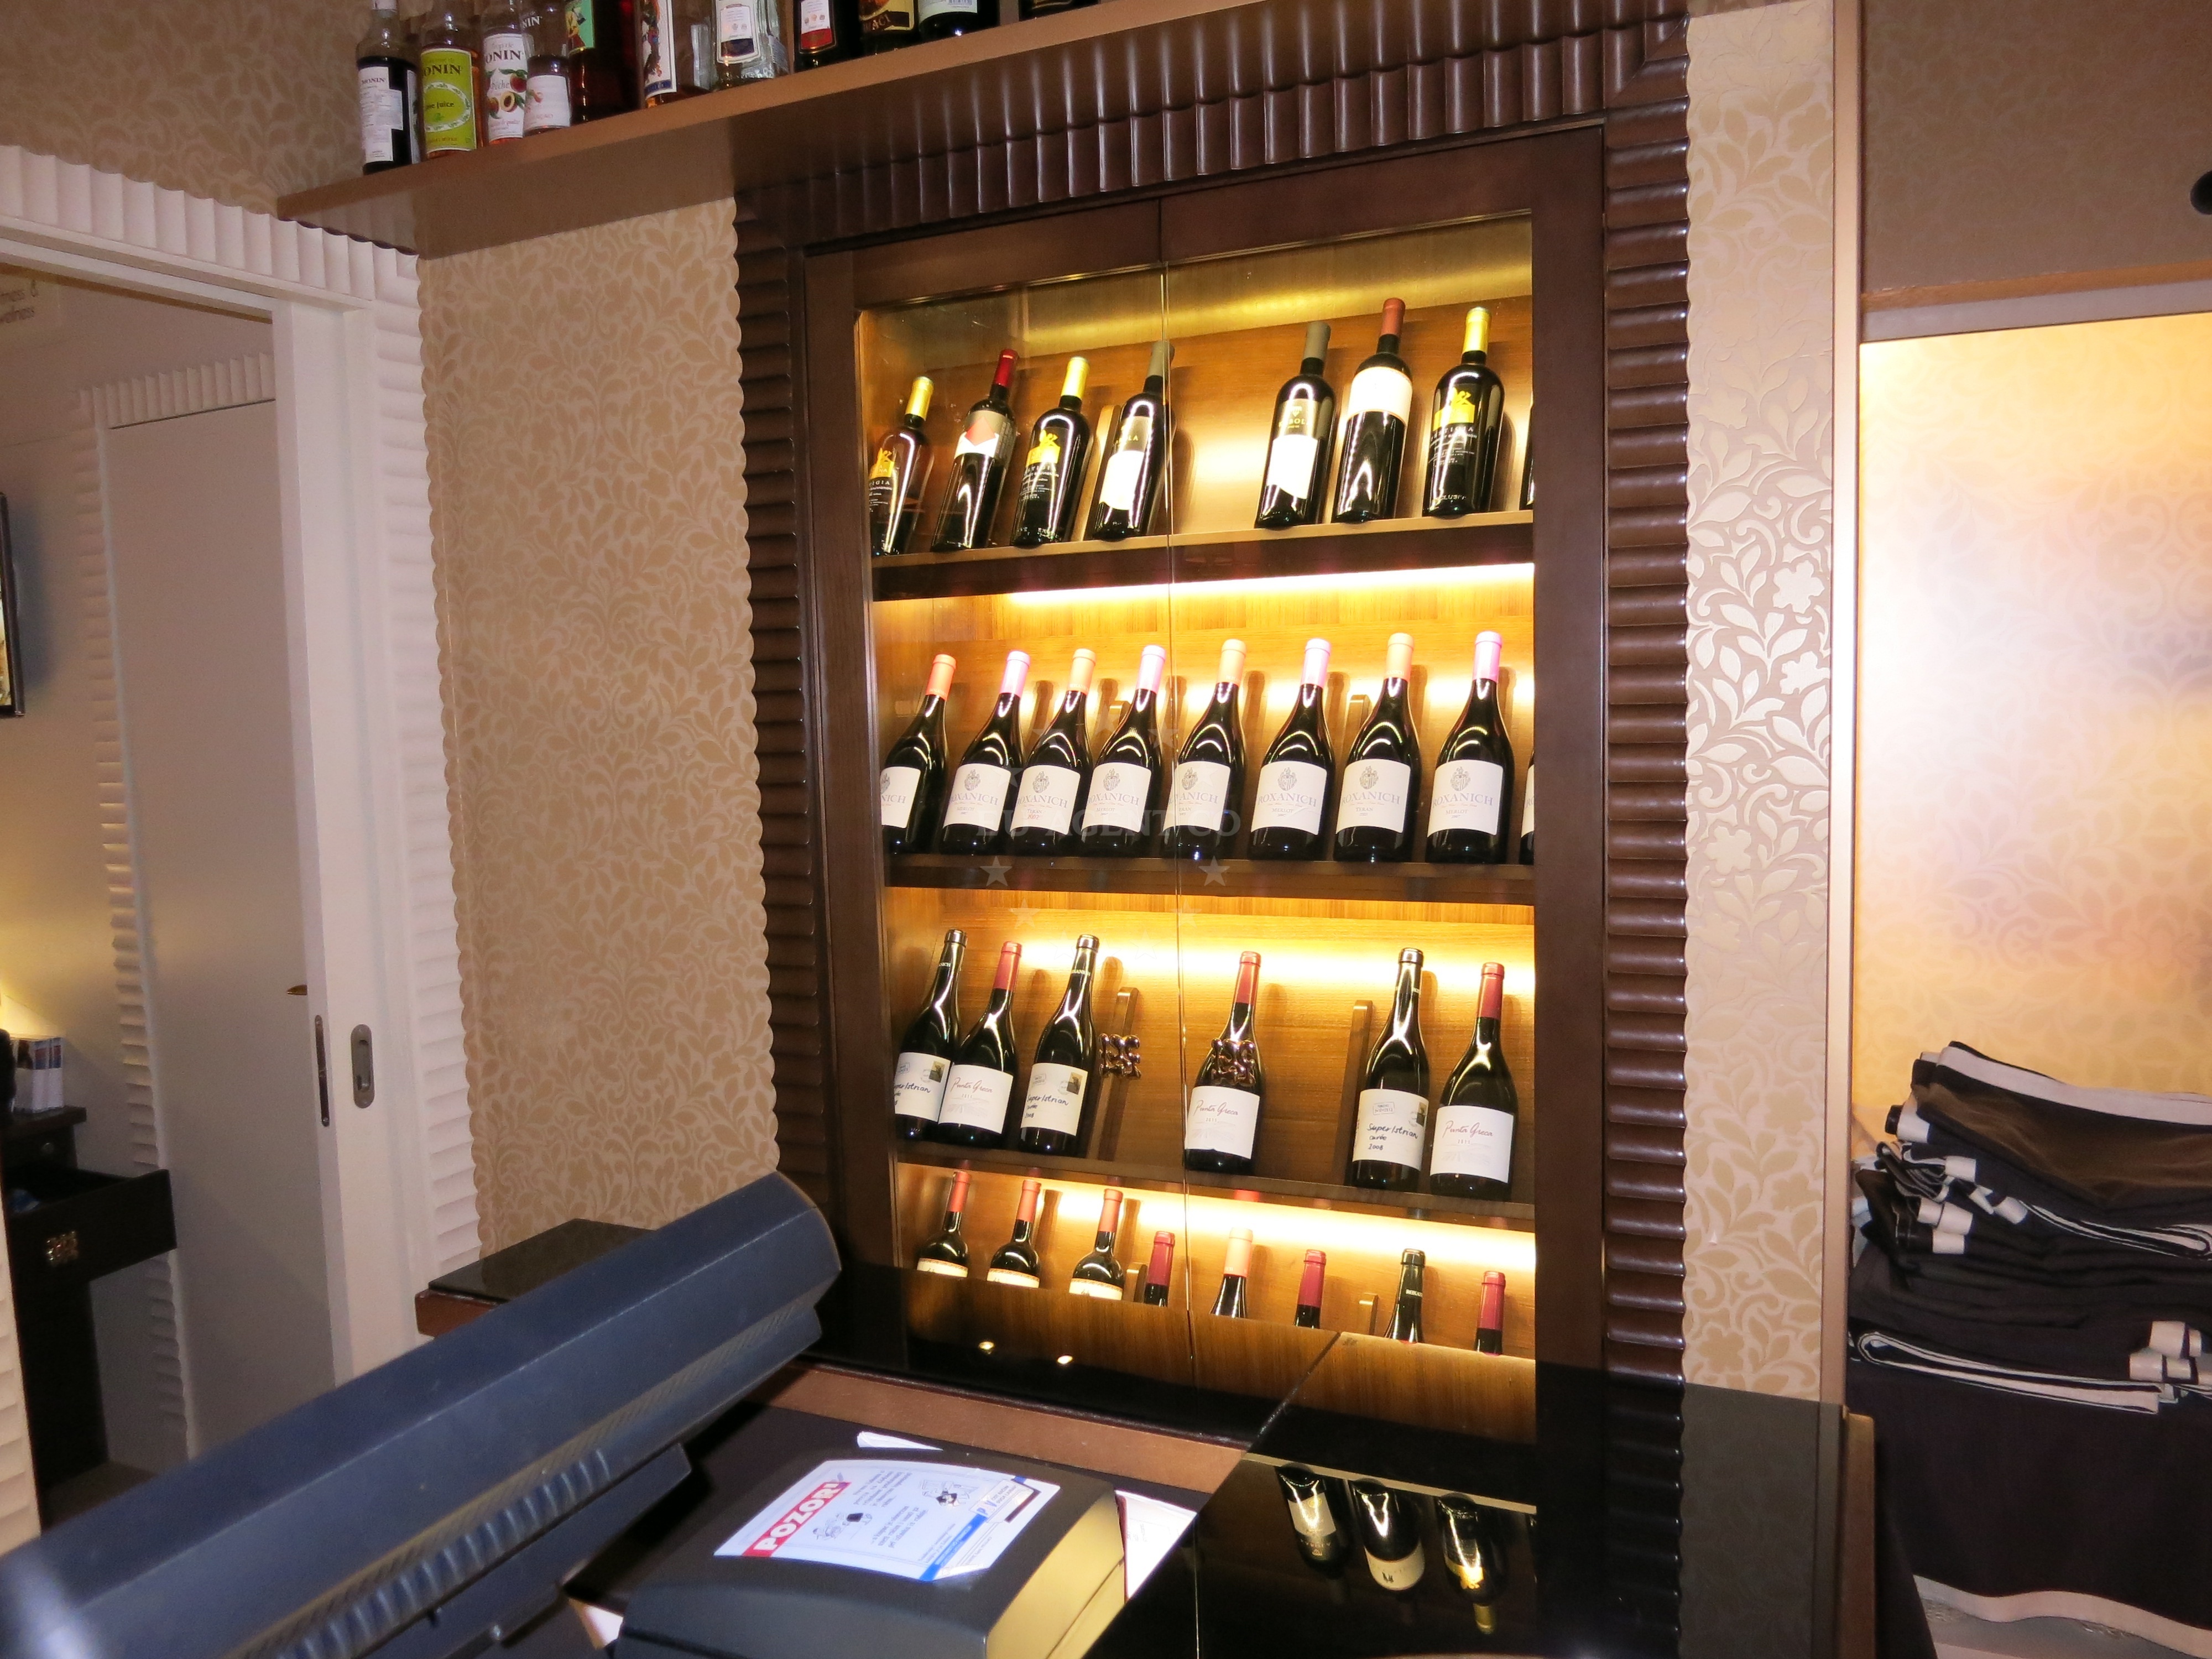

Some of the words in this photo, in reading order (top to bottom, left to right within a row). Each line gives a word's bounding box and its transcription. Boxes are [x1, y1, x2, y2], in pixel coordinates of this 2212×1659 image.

[523, 16, 540, 29] NIN
[486, 50, 521, 64] ONIN
[424, 64, 461, 76] ONIN
[881, 794, 906, 804] NICH
[950, 792, 998, 806] ROXANICH
[1017, 794, 1068, 808] ROXANICH
[1087, 792, 1140, 806] ROXANICH
[1258, 792, 1317, 807] ROXANICH
[1342, 791, 1400, 805] ROXANICH
[1432, 792, 1493, 808] ROXANICH
[950, 1077, 972, 1092] Punta
[1041, 1095, 1070, 1106] Istrian
[1193, 1100, 1217, 1116] Punta
[1217, 1102, 1239, 1117] Greca
[1366, 1123, 1390, 1133] Super
[1391, 1125, 1418, 1139] Istrian
[1442, 1120, 1469, 1139] Punta
[1469, 1122, 1494, 1138] Greca
[753, 1481, 847, 1550] POZOR!
